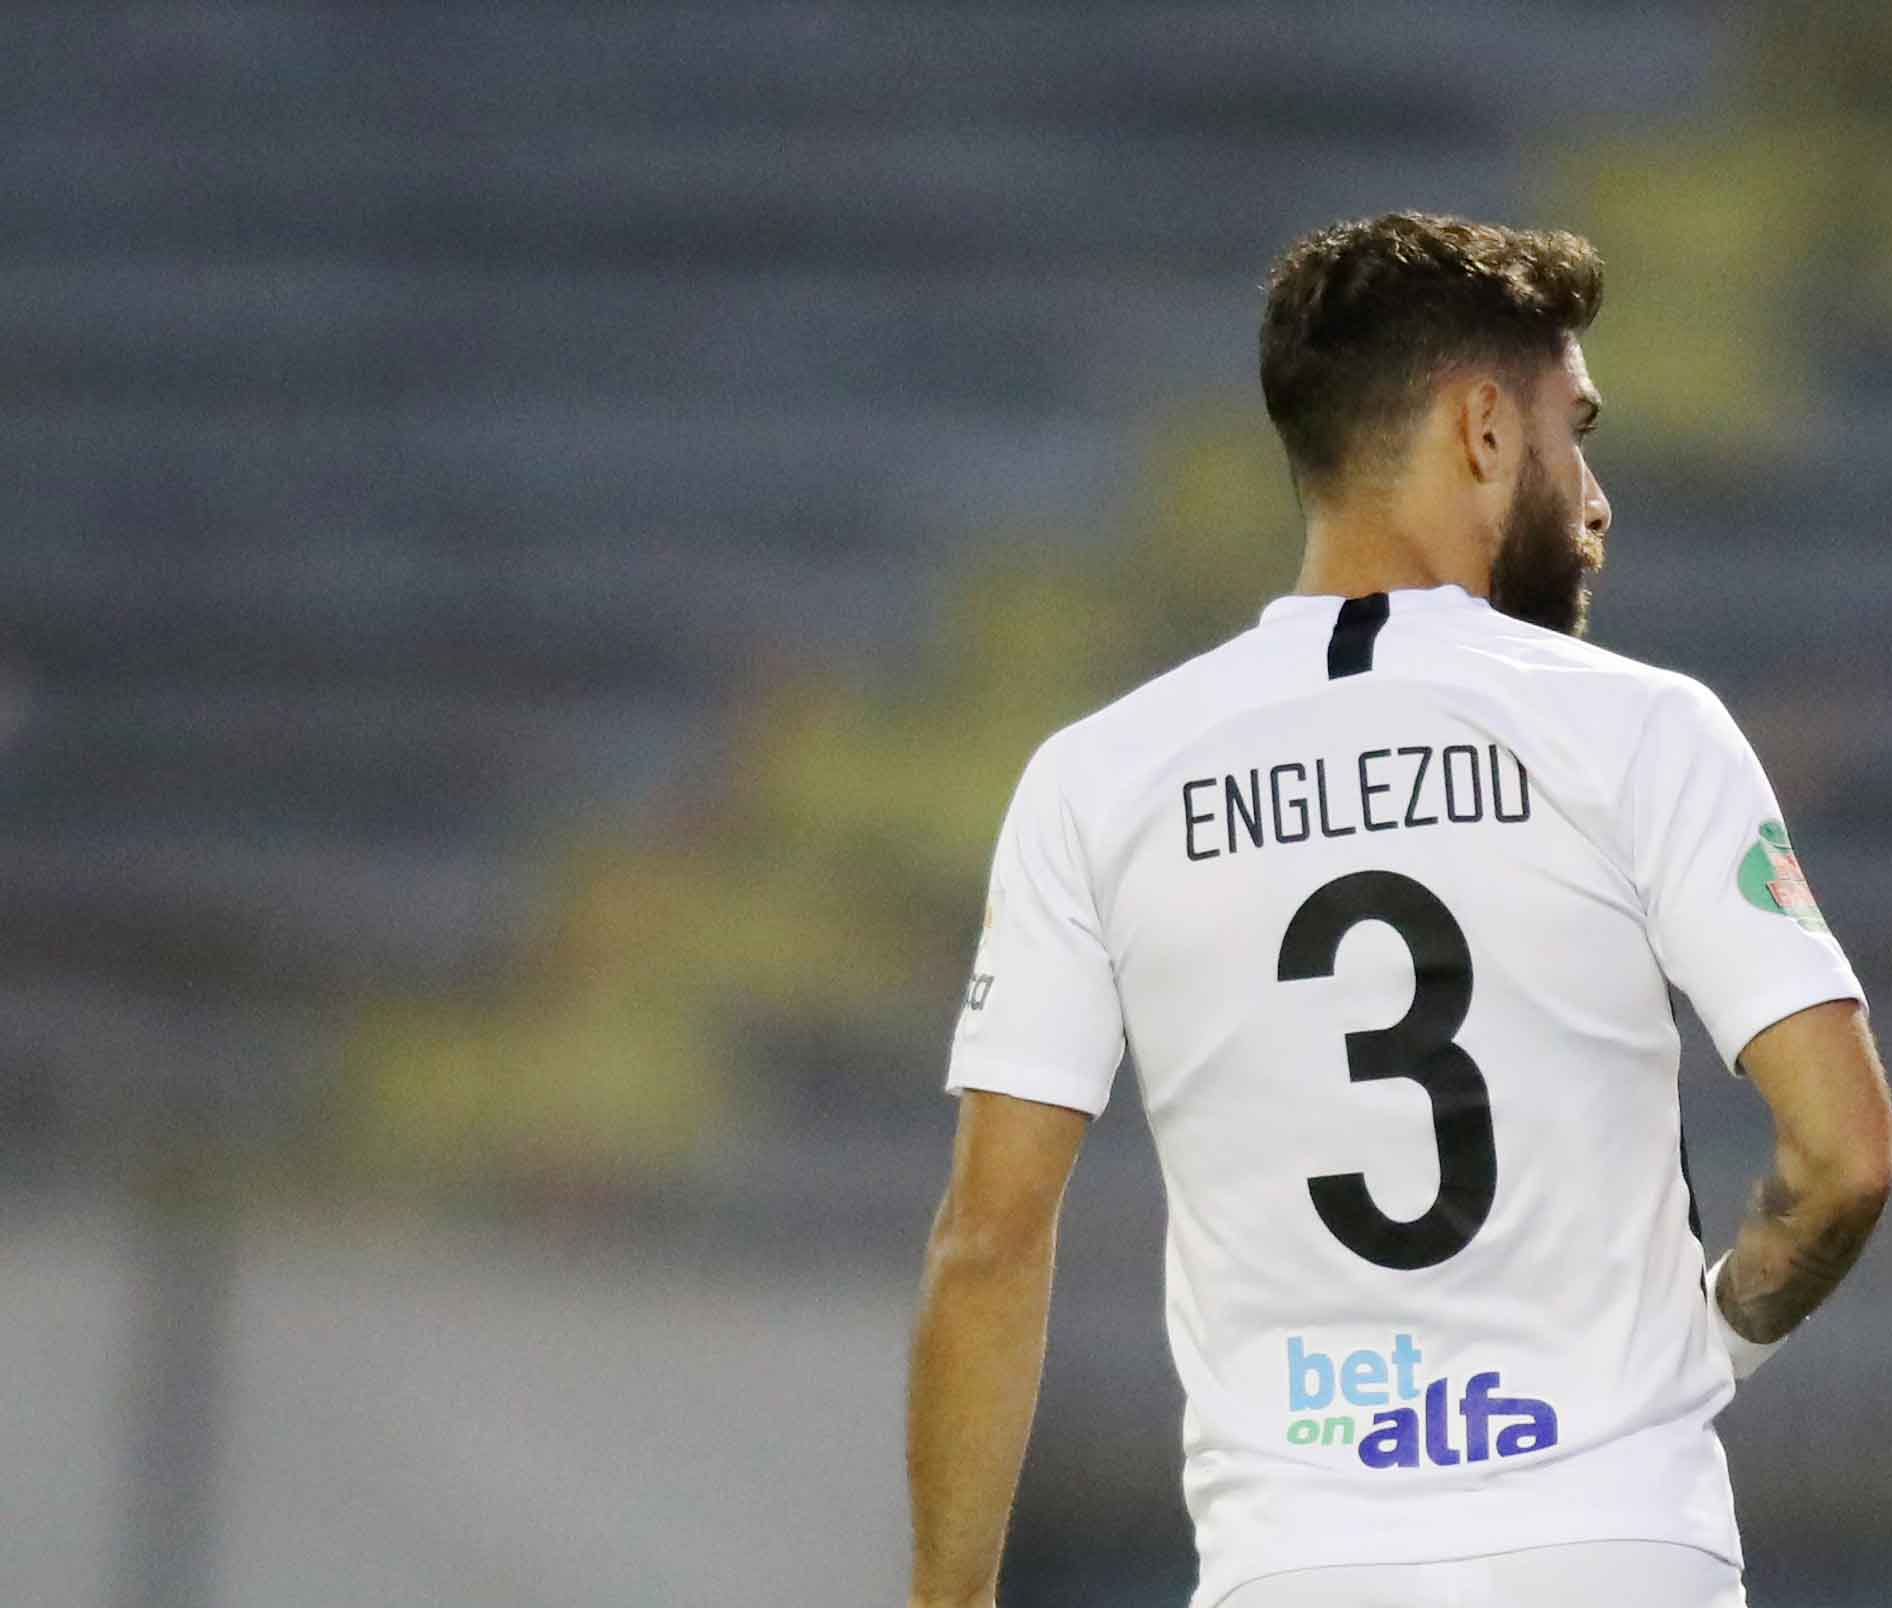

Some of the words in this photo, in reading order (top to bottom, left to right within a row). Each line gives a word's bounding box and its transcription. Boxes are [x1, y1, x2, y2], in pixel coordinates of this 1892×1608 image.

[1183, 744, 1531, 861] ENGLEZOU
[1277, 870, 1498, 1271] 3
[1286, 1415, 1355, 1446] on
[1358, 1371, 1558, 1469] alfa
[1287, 1333, 1422, 1412] bet
